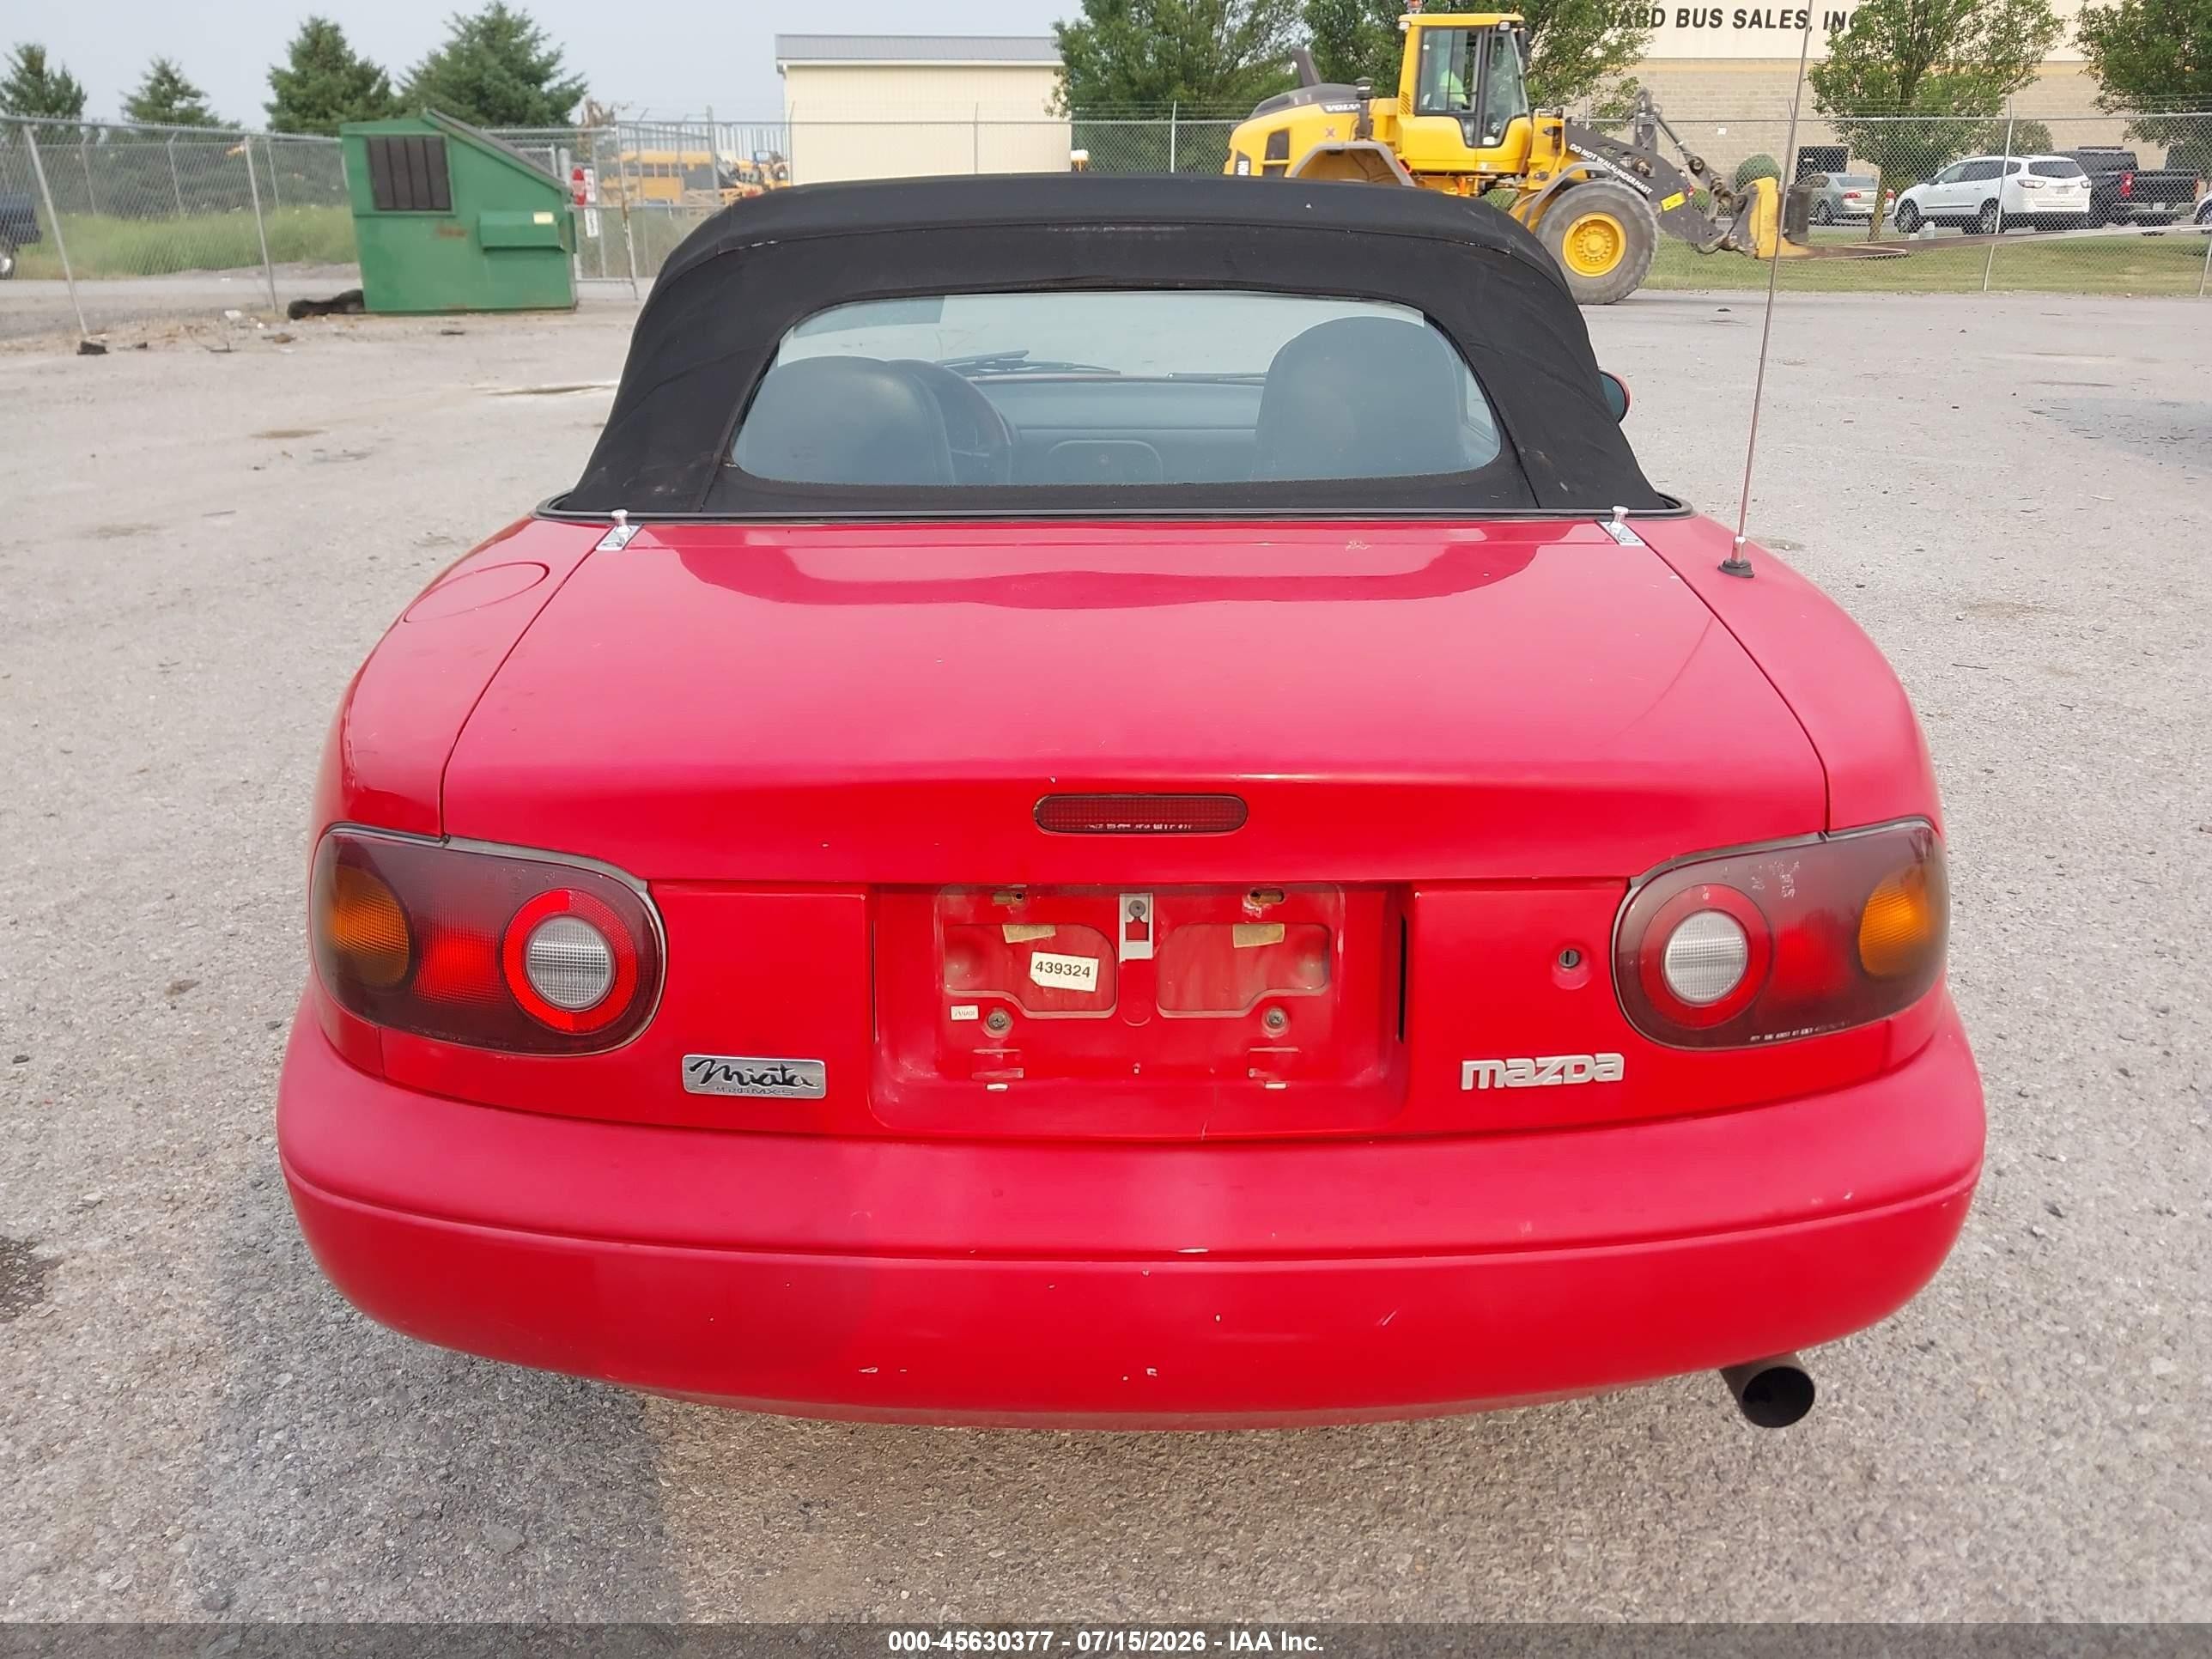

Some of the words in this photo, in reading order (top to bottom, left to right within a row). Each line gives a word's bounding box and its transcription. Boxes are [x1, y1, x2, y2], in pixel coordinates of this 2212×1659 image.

[1675, 8, 1723, 29] BUS
[1569, 143, 1582, 153] DO
[1581, 149, 1598, 160] NOT
[1596, 155, 1616, 171] WALK
[1613, 167, 1637, 185] UNDER
[1634, 180, 1654, 195] MAST
[1035, 961, 1091, 978] 439324
[689, 1059, 818, 1087] Miata
